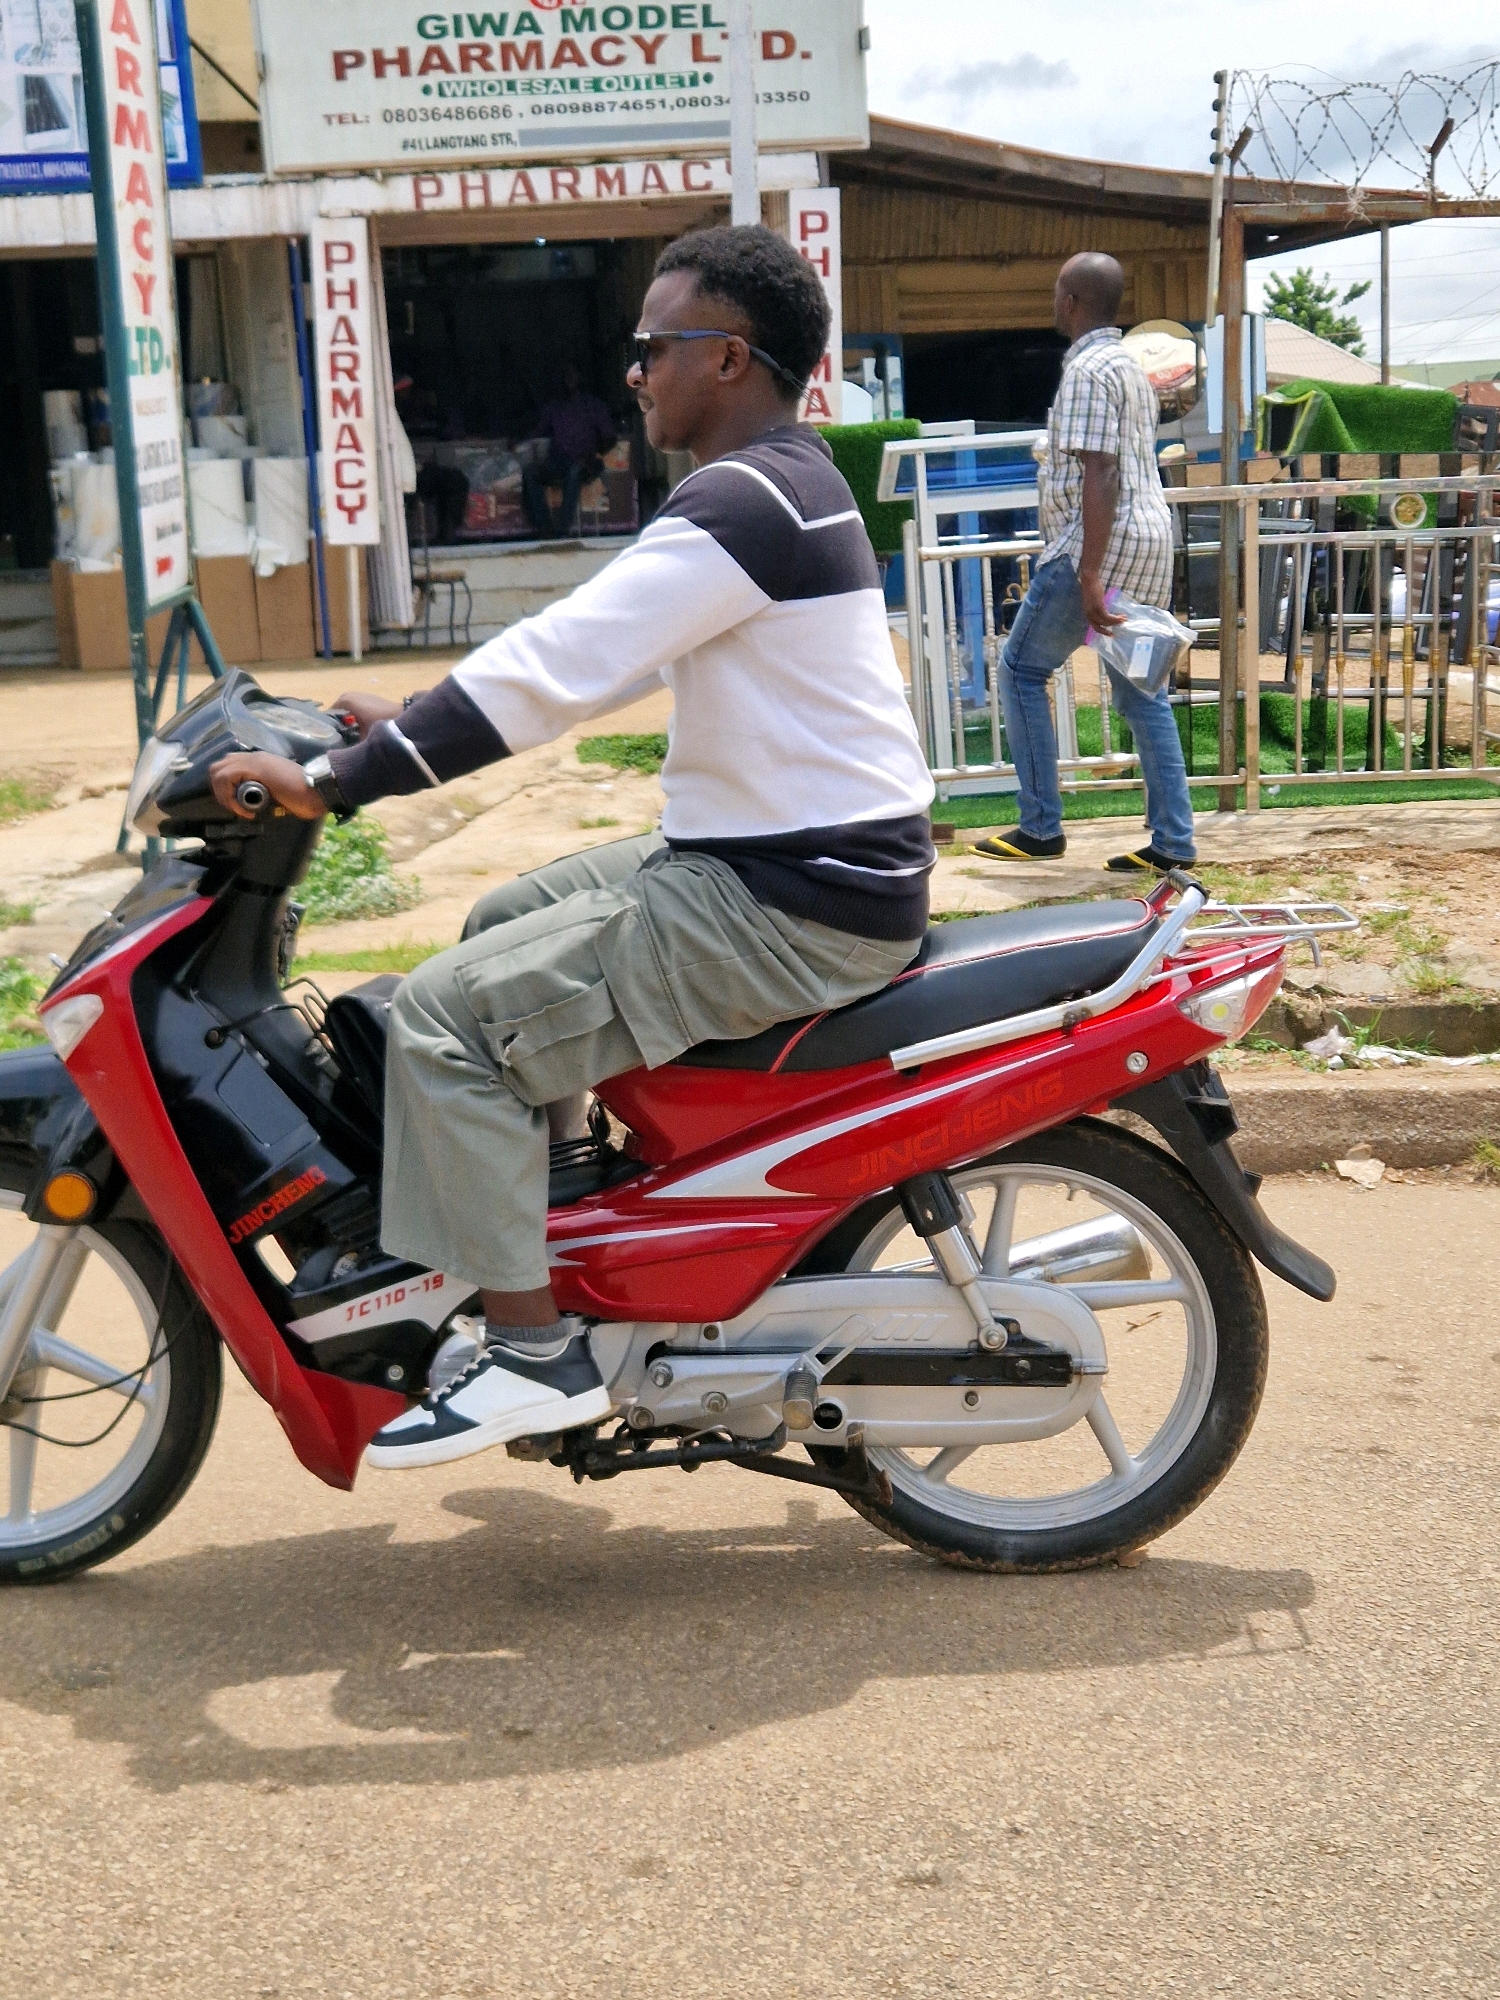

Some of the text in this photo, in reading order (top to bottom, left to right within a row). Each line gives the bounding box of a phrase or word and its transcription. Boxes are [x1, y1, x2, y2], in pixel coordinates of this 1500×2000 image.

[416, 4, 726, 39] GIWA MODEL
[332, 29, 812, 81] PHARMACY LD.
[440, 72, 697, 97] WHOLESALE OUTLET
[323, 113, 370, 126] TEL:
[411, 158, 734, 211] PHARMAC
[324, 241, 368, 525] PHARMACY
[228, 1164, 327, 1244] JINCHENG
